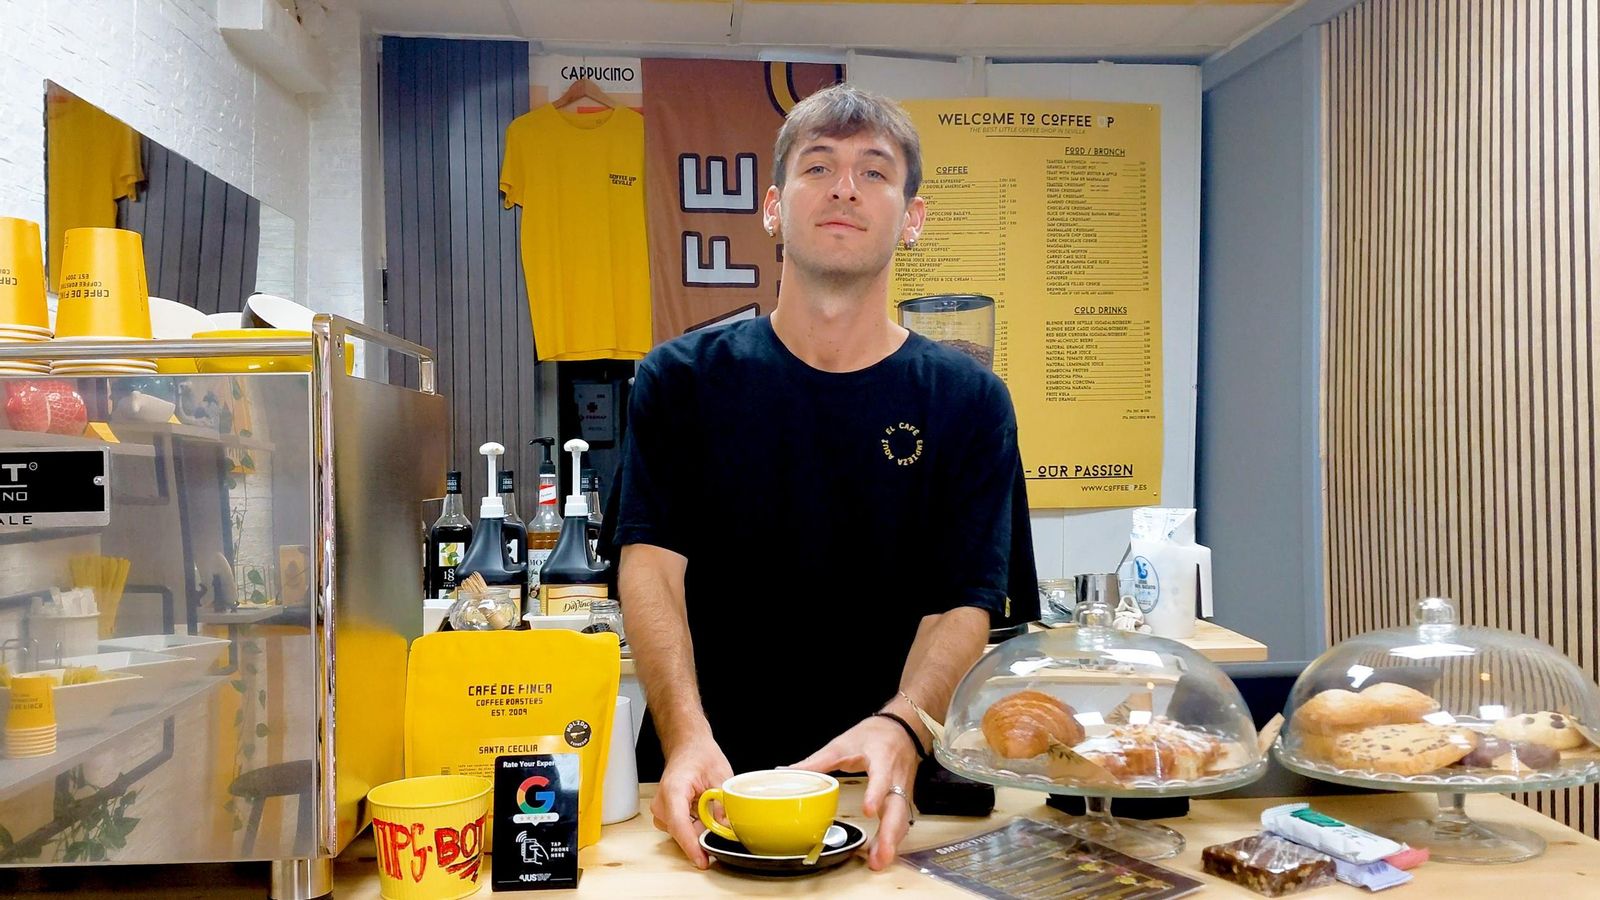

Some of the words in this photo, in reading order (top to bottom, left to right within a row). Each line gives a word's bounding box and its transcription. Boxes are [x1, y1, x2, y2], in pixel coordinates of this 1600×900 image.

[561, 66, 634, 81] CAPPUCINO
[938, 112, 1015, 126] WELCOME
[1020, 113, 1035, 125] TO
[1041, 114, 1092, 127] COFFEE
[1065, 147, 1085, 155] FOOD
[936, 166, 968, 174] COFFEE
[71, 290, 81, 298] DE
[1038, 465, 1068, 477] OUR
[1074, 464, 1133, 476] PASSION
[468, 684, 497, 697] CAFÉ
[500, 684, 515, 695] DE
[518, 684, 552, 695] FINCA
[476, 699, 504, 707] COFFEE
[506, 698, 543, 706] ROASTERS
[479, 746, 505, 755] SANTA
[508, 745, 538, 753] CECILIA
[503, 761, 519, 769] Rate
